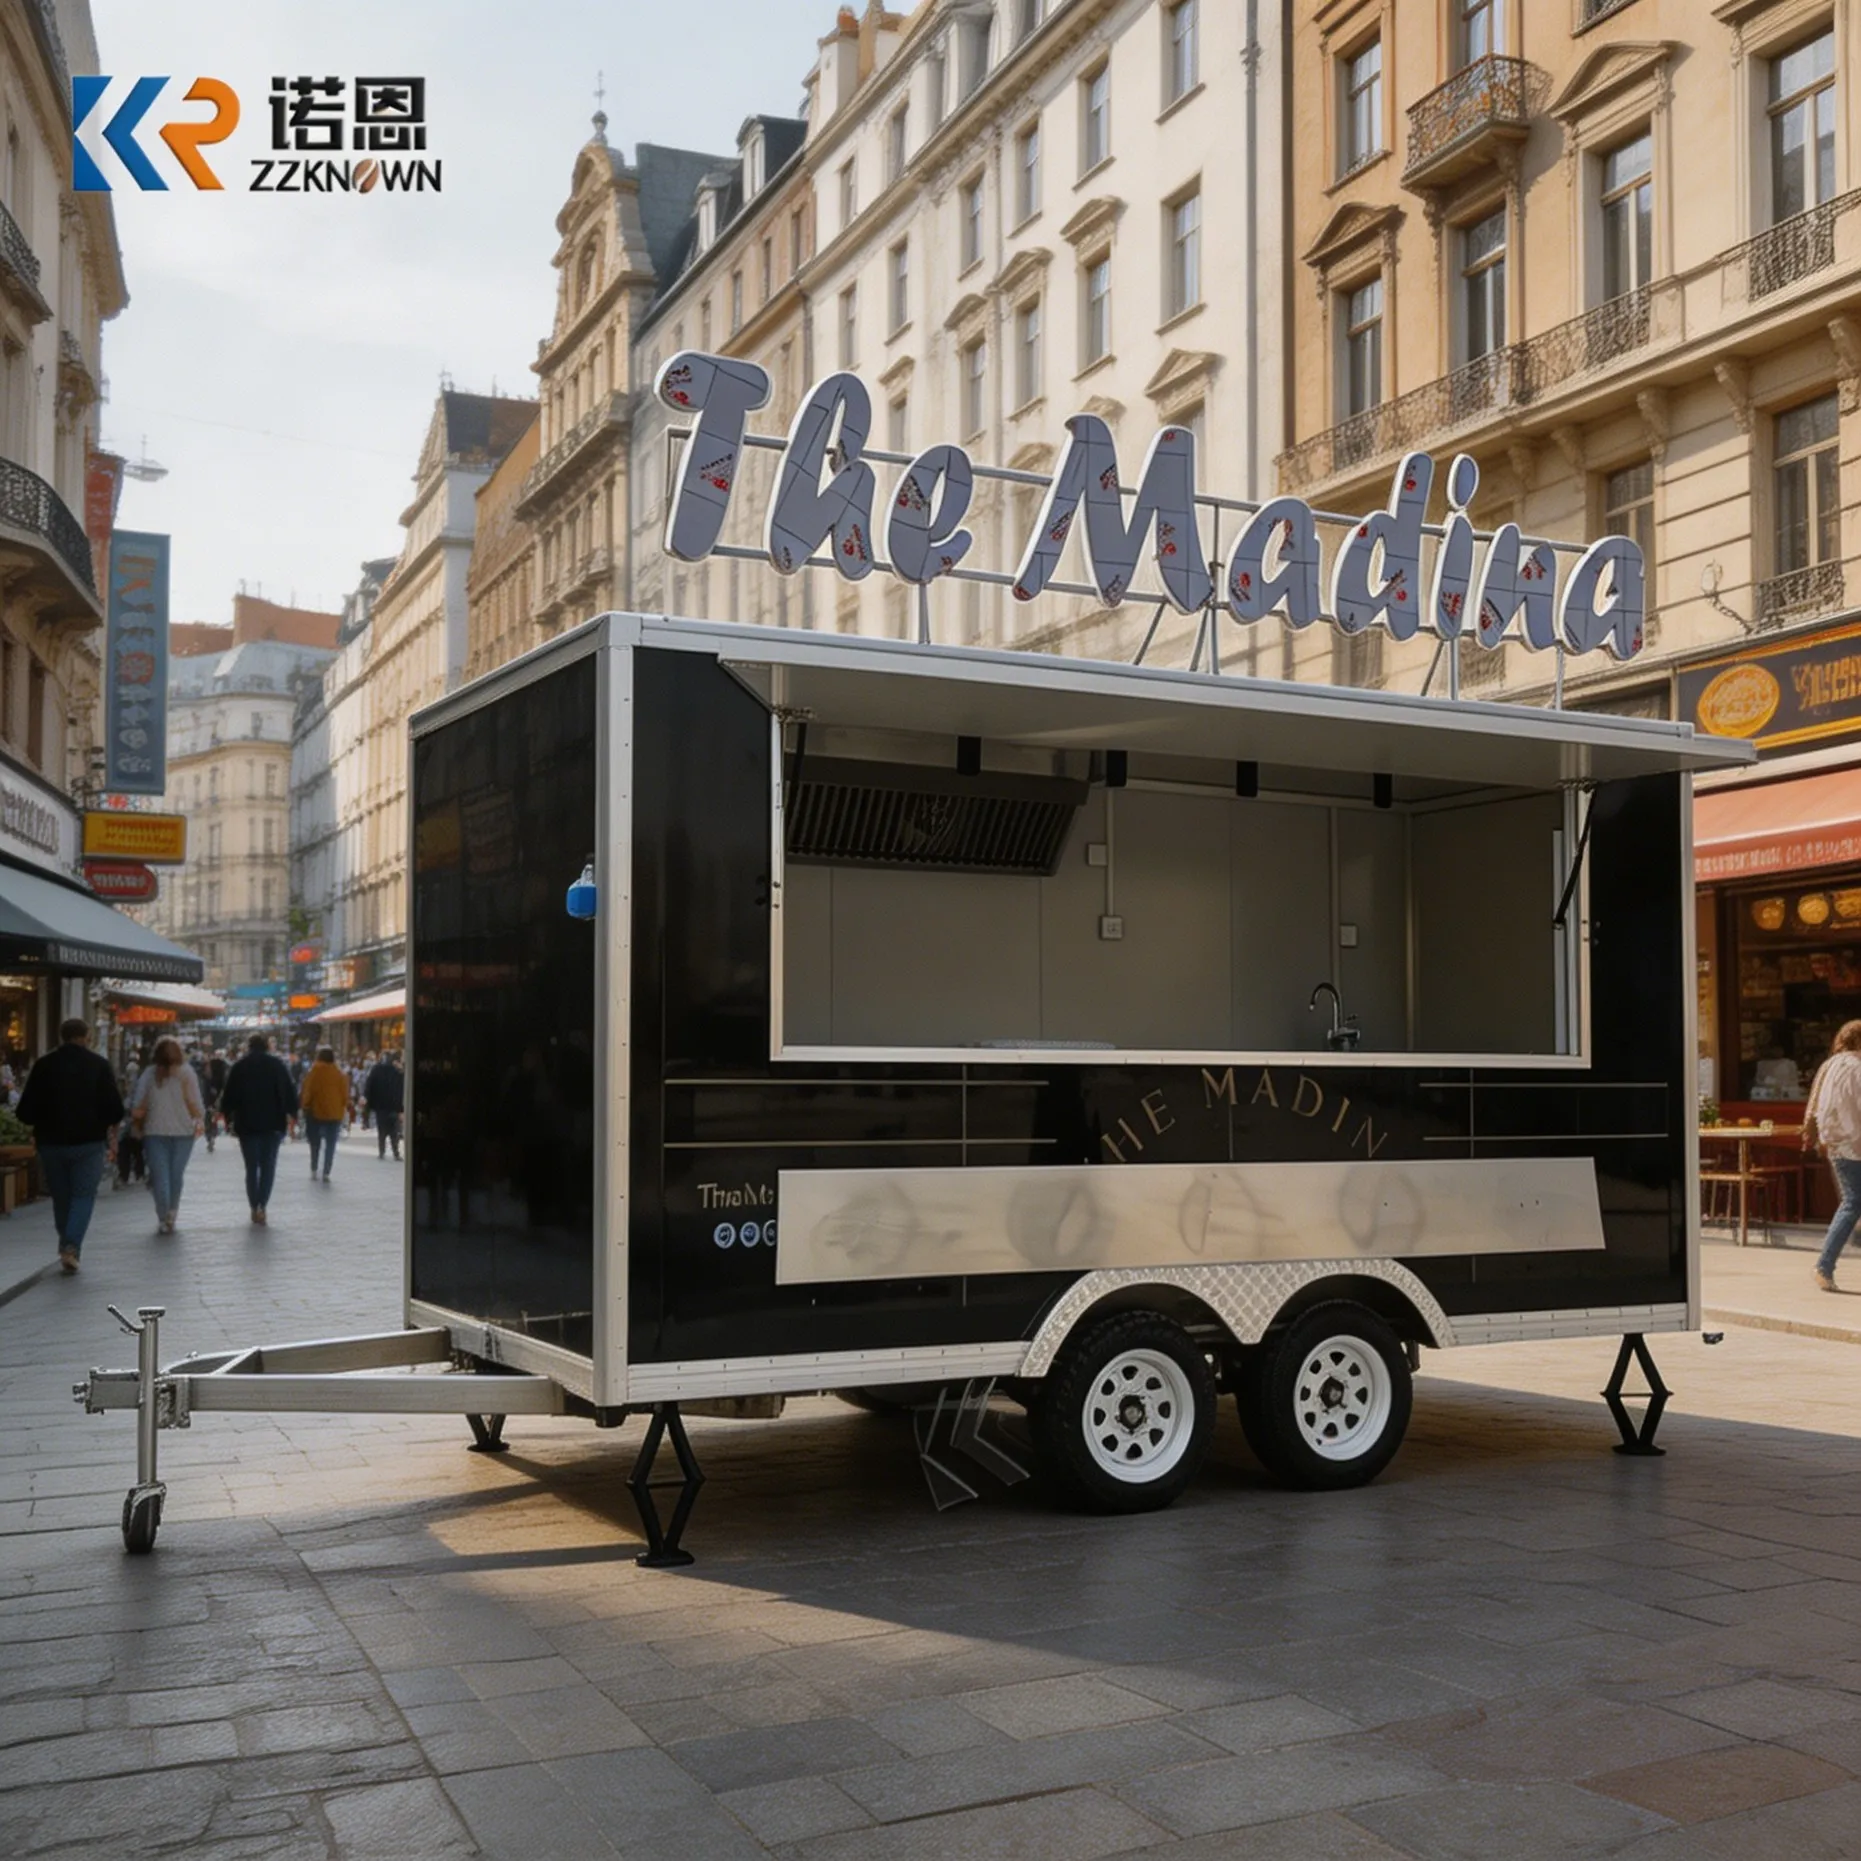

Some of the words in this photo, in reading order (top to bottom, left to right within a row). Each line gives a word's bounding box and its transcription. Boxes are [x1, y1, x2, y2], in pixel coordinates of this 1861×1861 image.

[654, 350, 973, 584] The
[1011, 414, 1645, 660] Madina
[1101, 1088, 1176, 1163] HE
